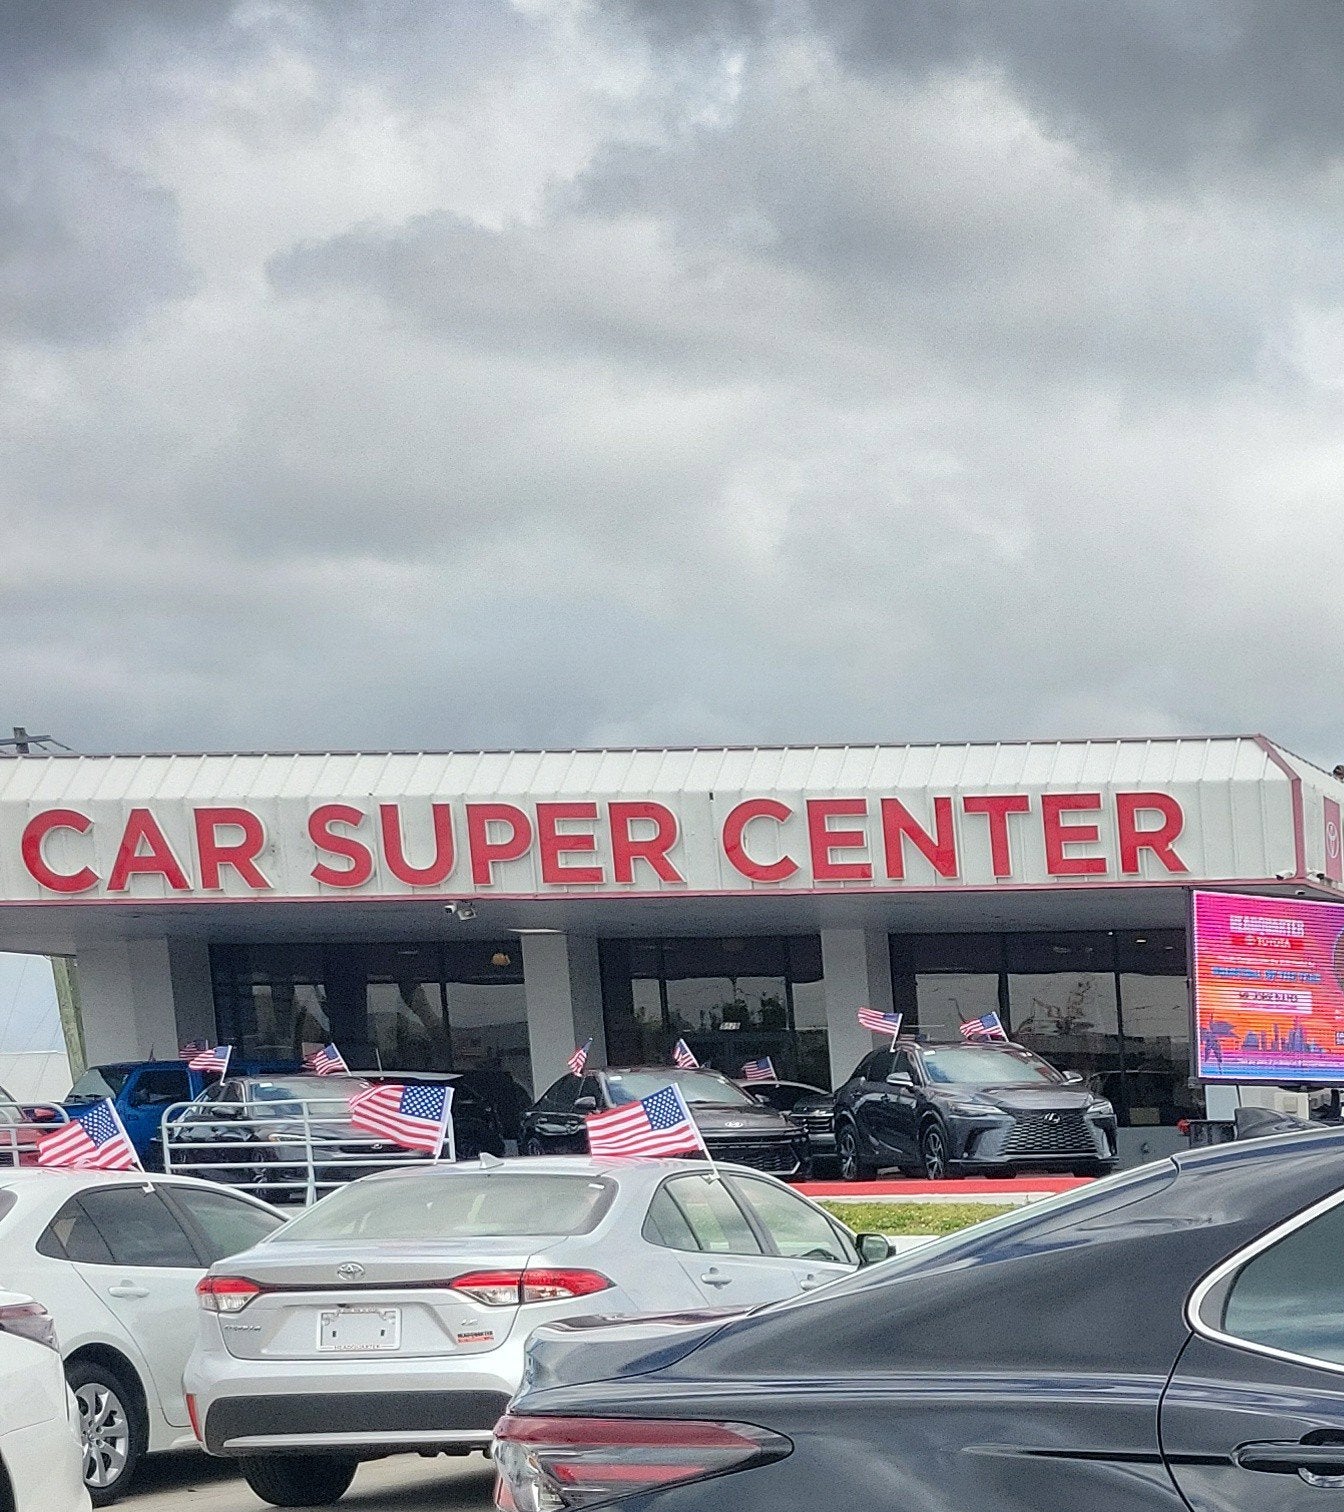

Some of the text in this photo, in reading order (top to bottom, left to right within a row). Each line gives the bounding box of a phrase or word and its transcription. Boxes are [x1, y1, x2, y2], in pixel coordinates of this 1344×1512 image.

[21, 791, 1191, 893] CAR SUPER CENTER
[1257, 938, 1291, 949] TOYOTA
